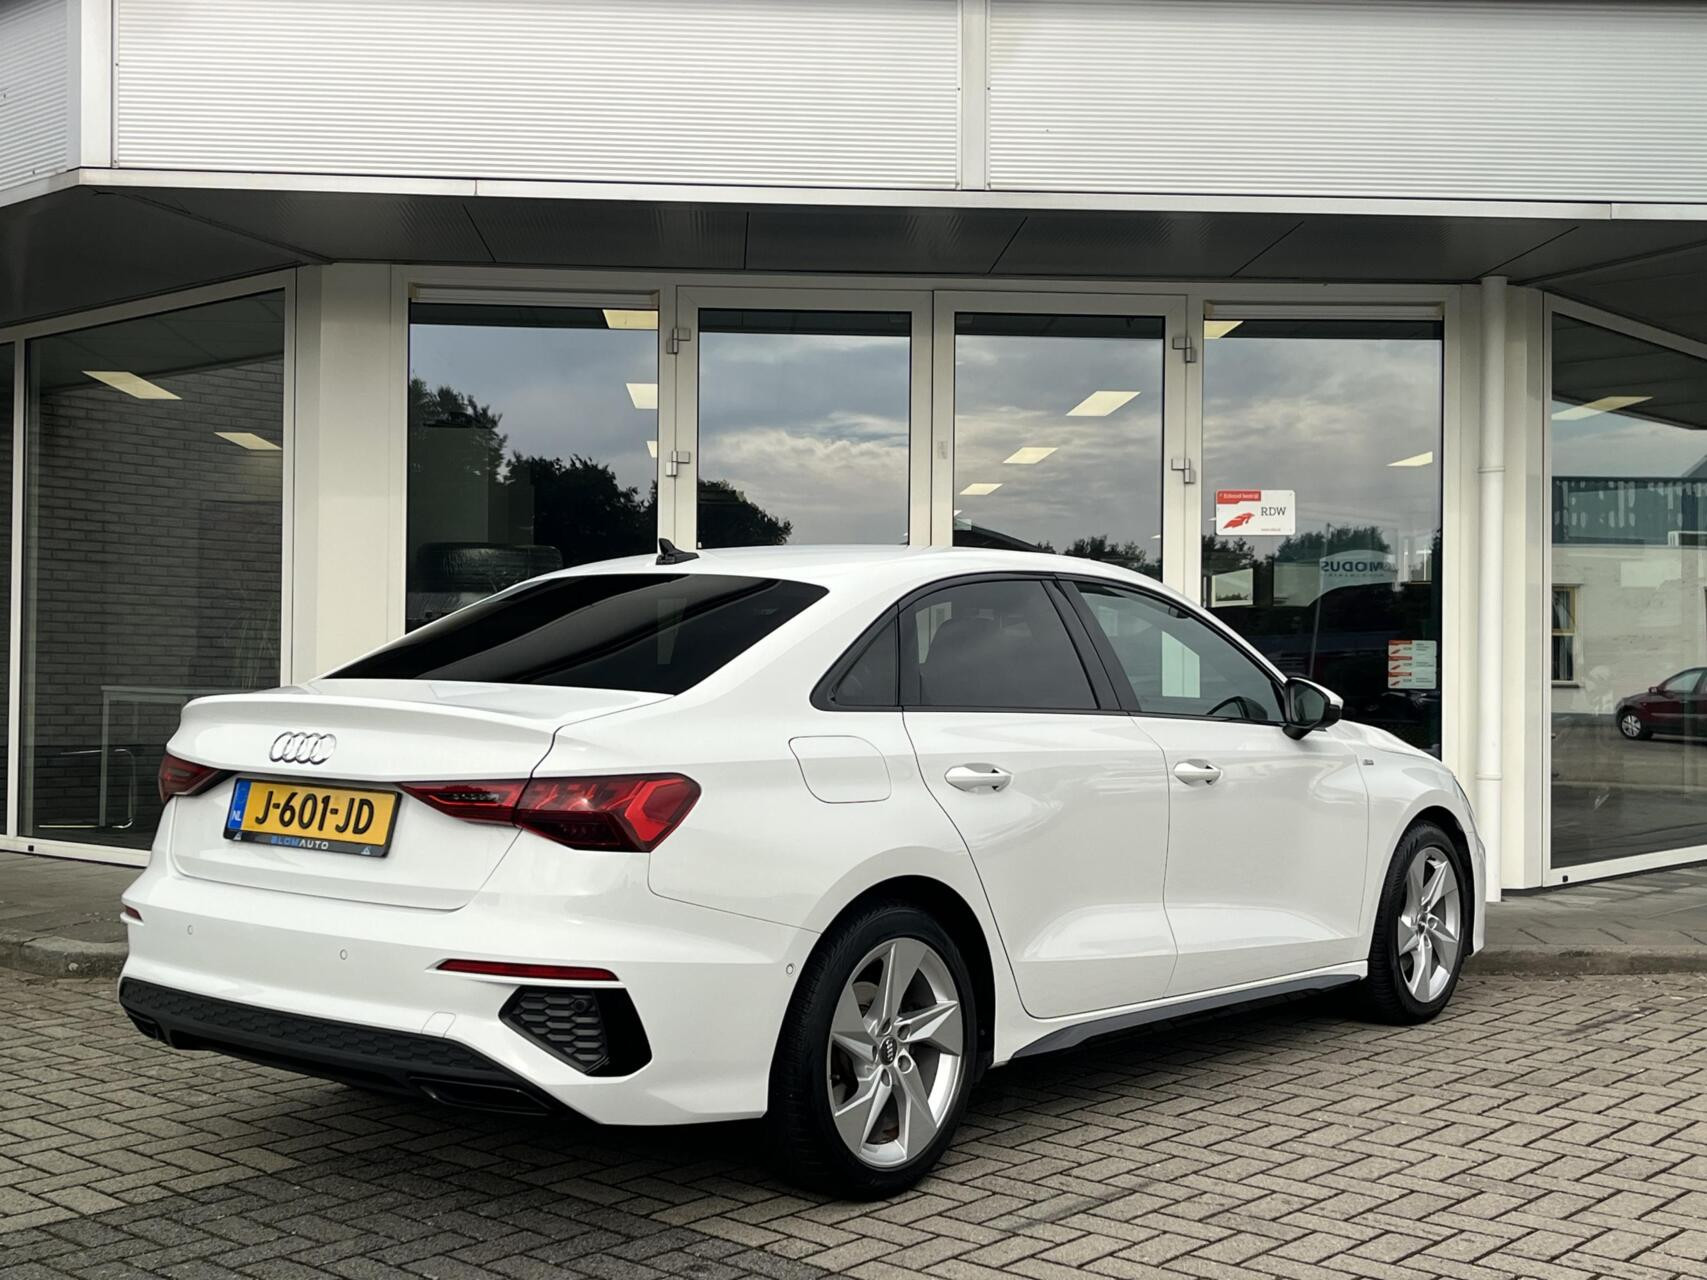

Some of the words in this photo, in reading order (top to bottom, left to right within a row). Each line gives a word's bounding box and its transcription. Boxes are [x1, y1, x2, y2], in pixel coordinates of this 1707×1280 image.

[1260, 506, 1287, 516] RDW
[231, 810, 242, 822] NL
[254, 791, 375, 835] J-601-JD
